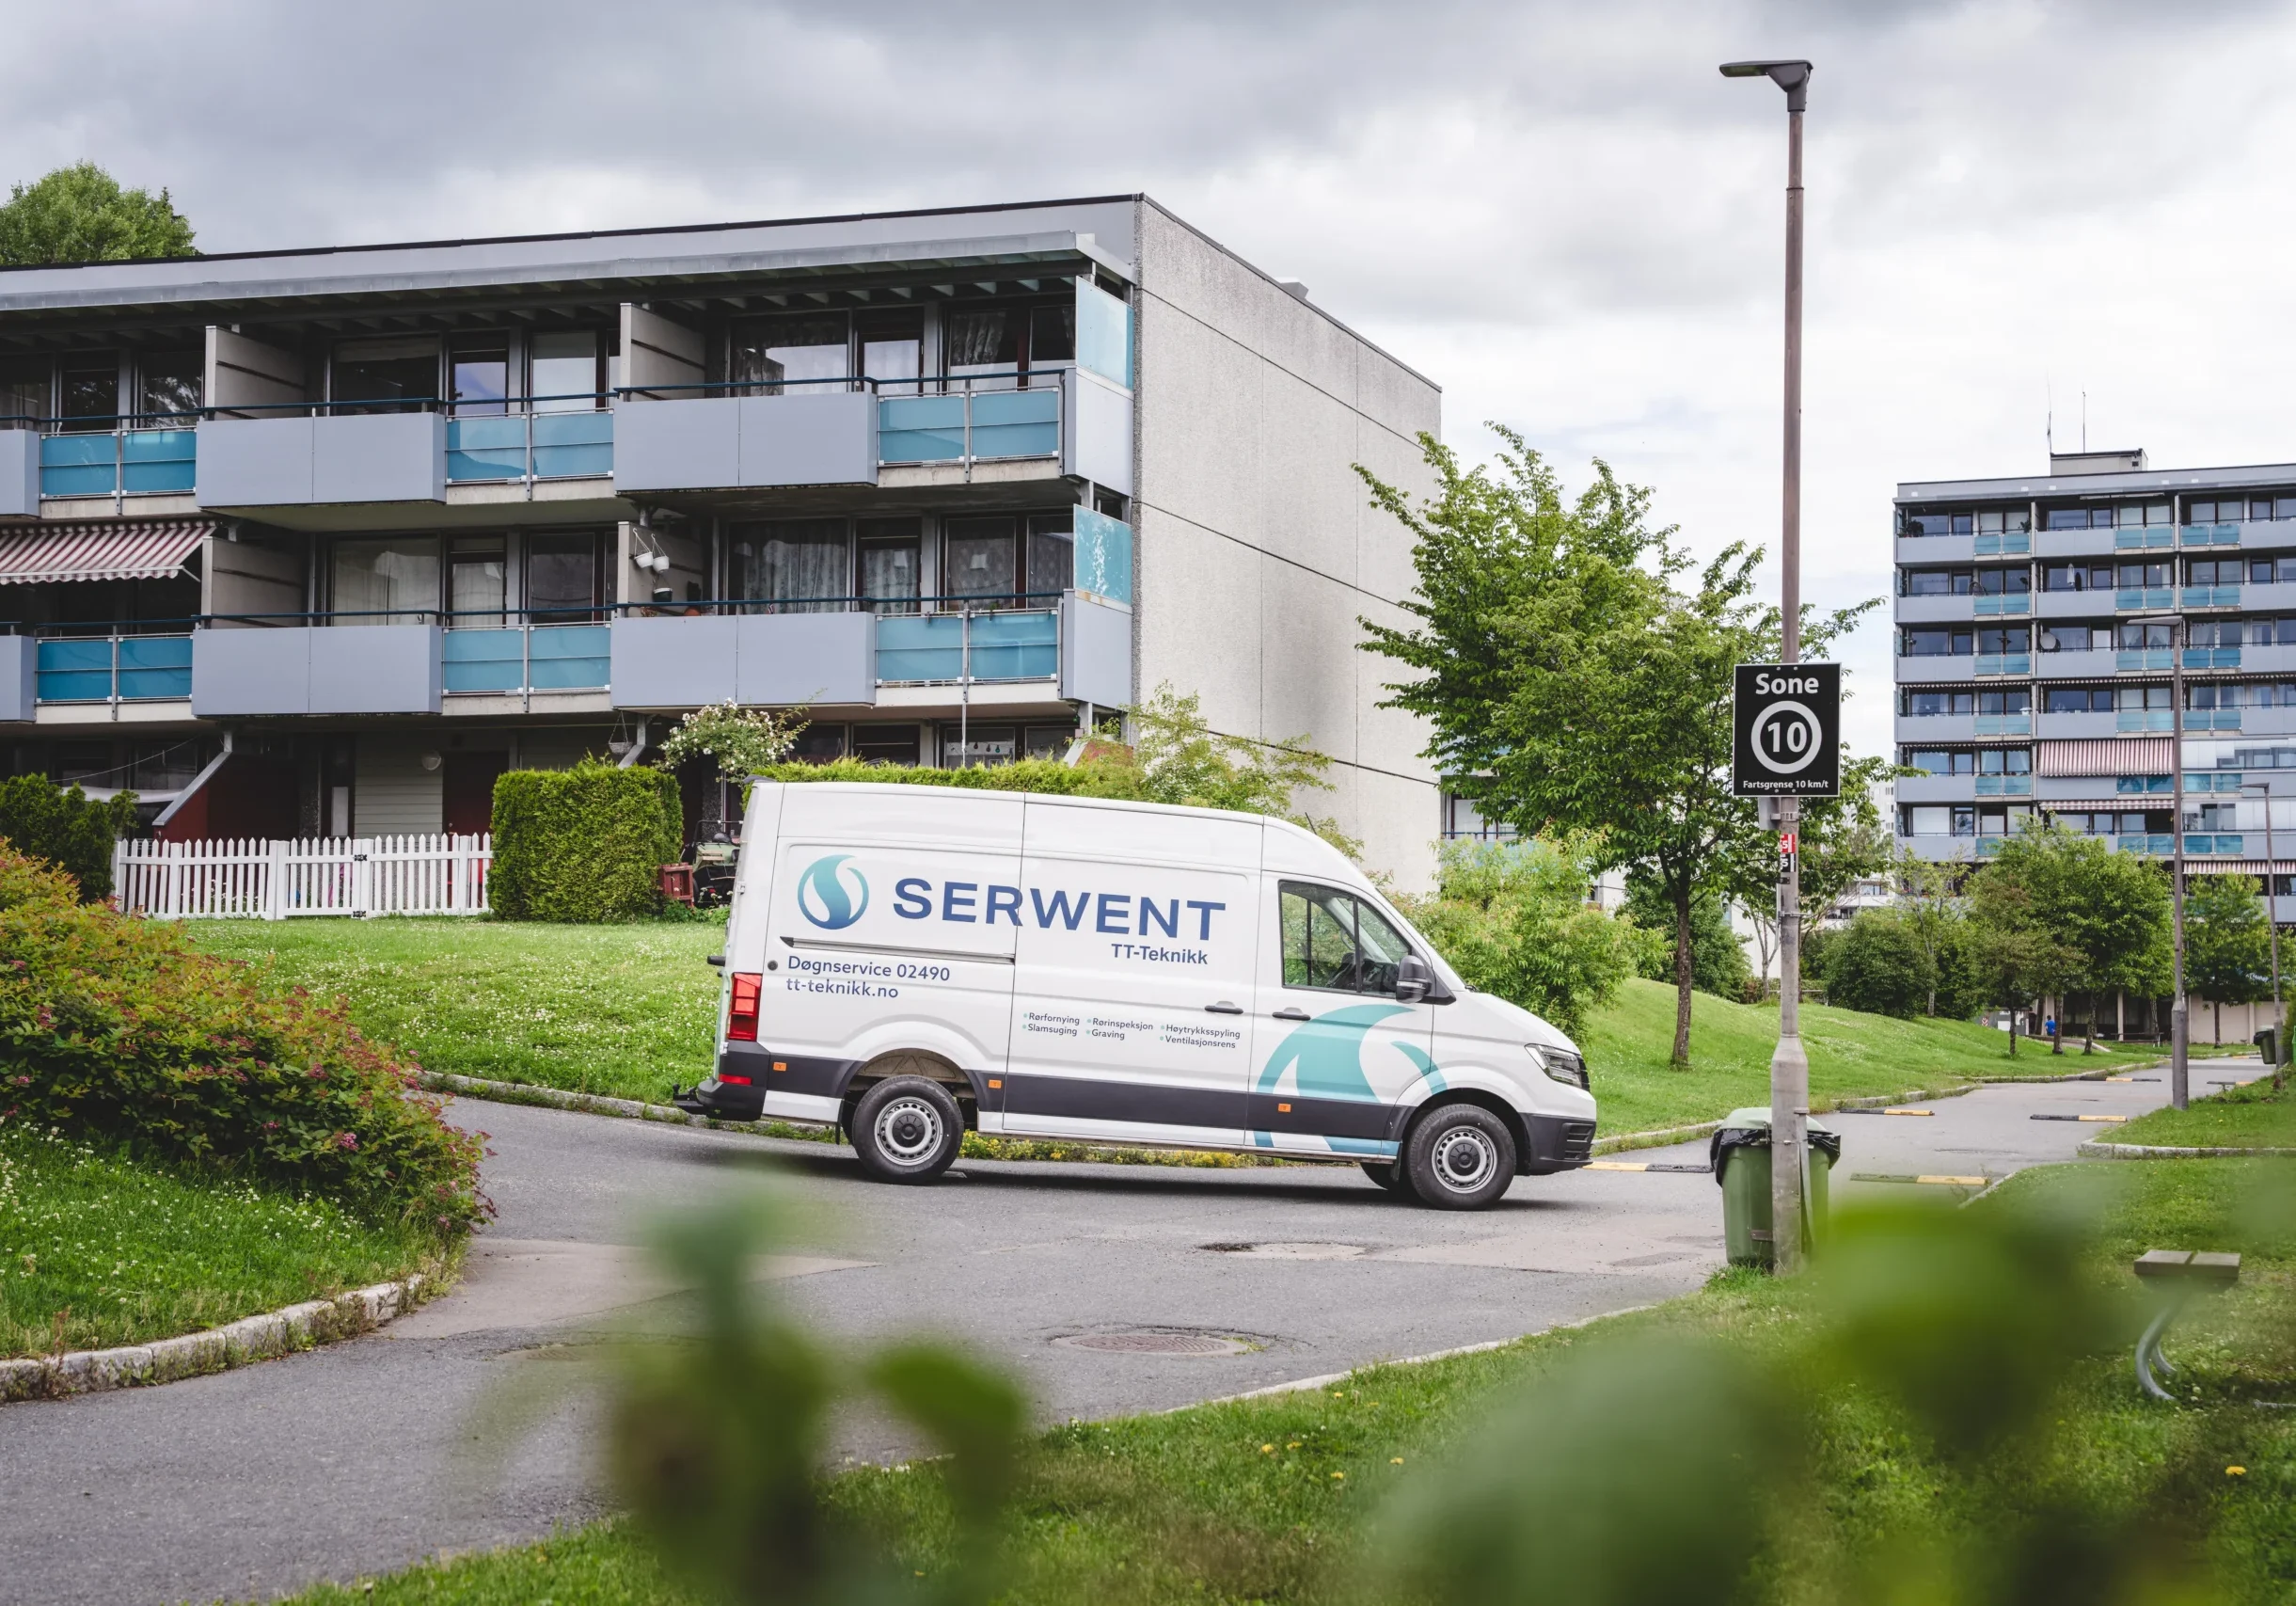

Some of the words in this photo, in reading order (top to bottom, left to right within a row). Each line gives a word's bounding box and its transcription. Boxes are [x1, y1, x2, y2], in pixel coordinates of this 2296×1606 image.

[1755, 673, 1819, 695] Sone
[1767, 721, 1807, 753] 10
[1743, 780, 1793, 790] Fartsgrense
[1796, 780, 1806, 788] 10
[1807, 779, 1829, 788] km/t
[893, 878, 1226, 941] SERWENT
[1111, 943, 1209, 965] TT-Teknikk
[787, 955, 892, 977] Døgnservice
[896, 963, 950, 981] 02490
[785, 978, 899, 998] tt-teknikk.no
[1028, 1011, 1080, 1026] Rørfornying
[1092, 1017, 1154, 1031] Rørinspeksjon
[1027, 1023, 1078, 1037] Slamsuging
[1091, 1028, 1125, 1041] Graving
[1165, 1024, 1241, 1040] Høytrykksspyling
[1164, 1035, 1236, 1049] Ventilasjonsrens
